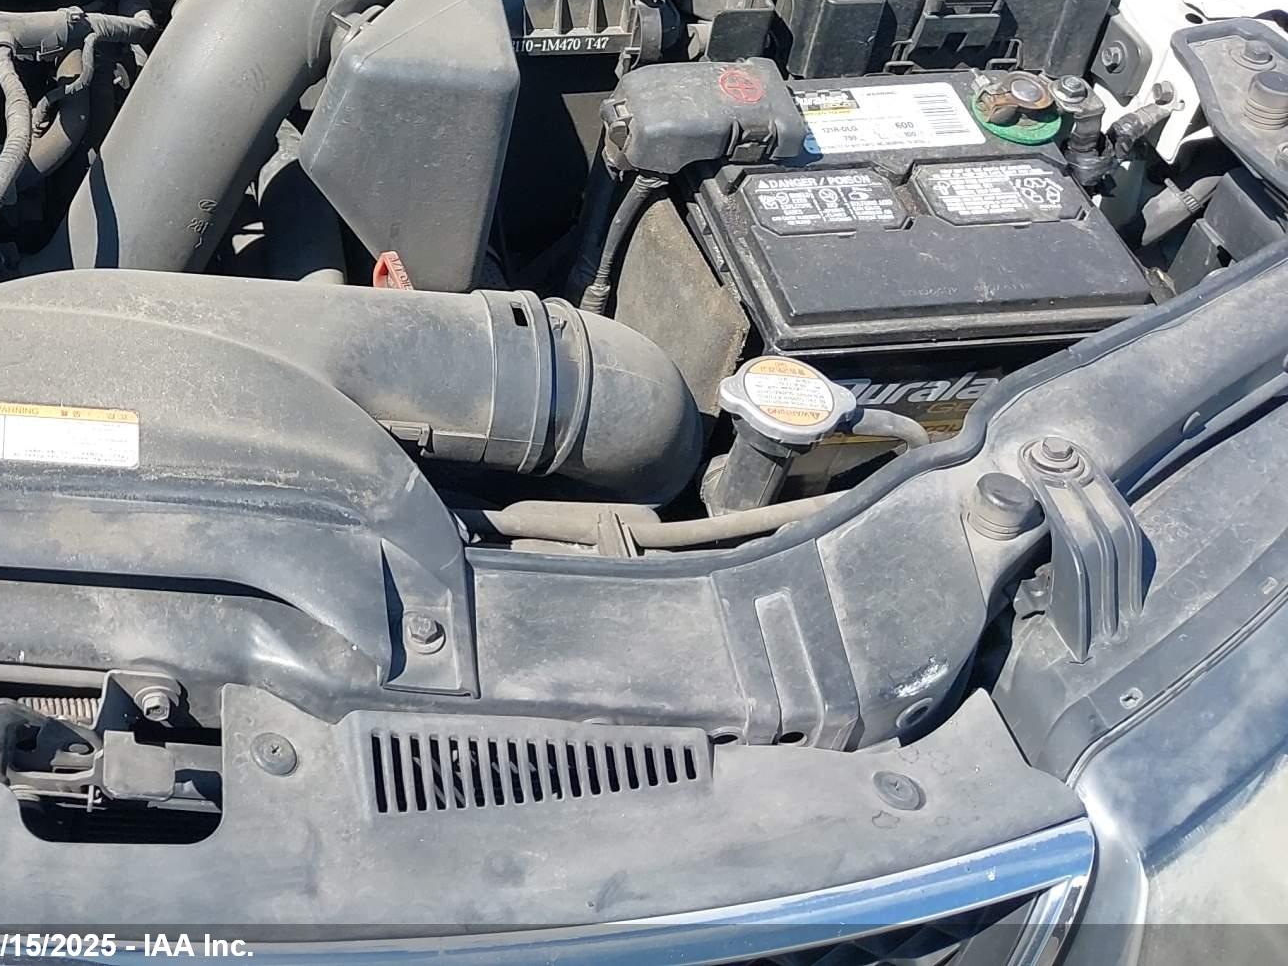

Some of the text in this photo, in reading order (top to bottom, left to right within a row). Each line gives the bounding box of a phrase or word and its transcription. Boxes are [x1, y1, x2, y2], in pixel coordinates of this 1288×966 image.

[585, 37, 609, 50] T47
[894, 121, 915, 130] 600
[768, 176, 818, 189] DANGER
[827, 174, 871, 186] POISON
[833, 371, 1000, 405] Durala
